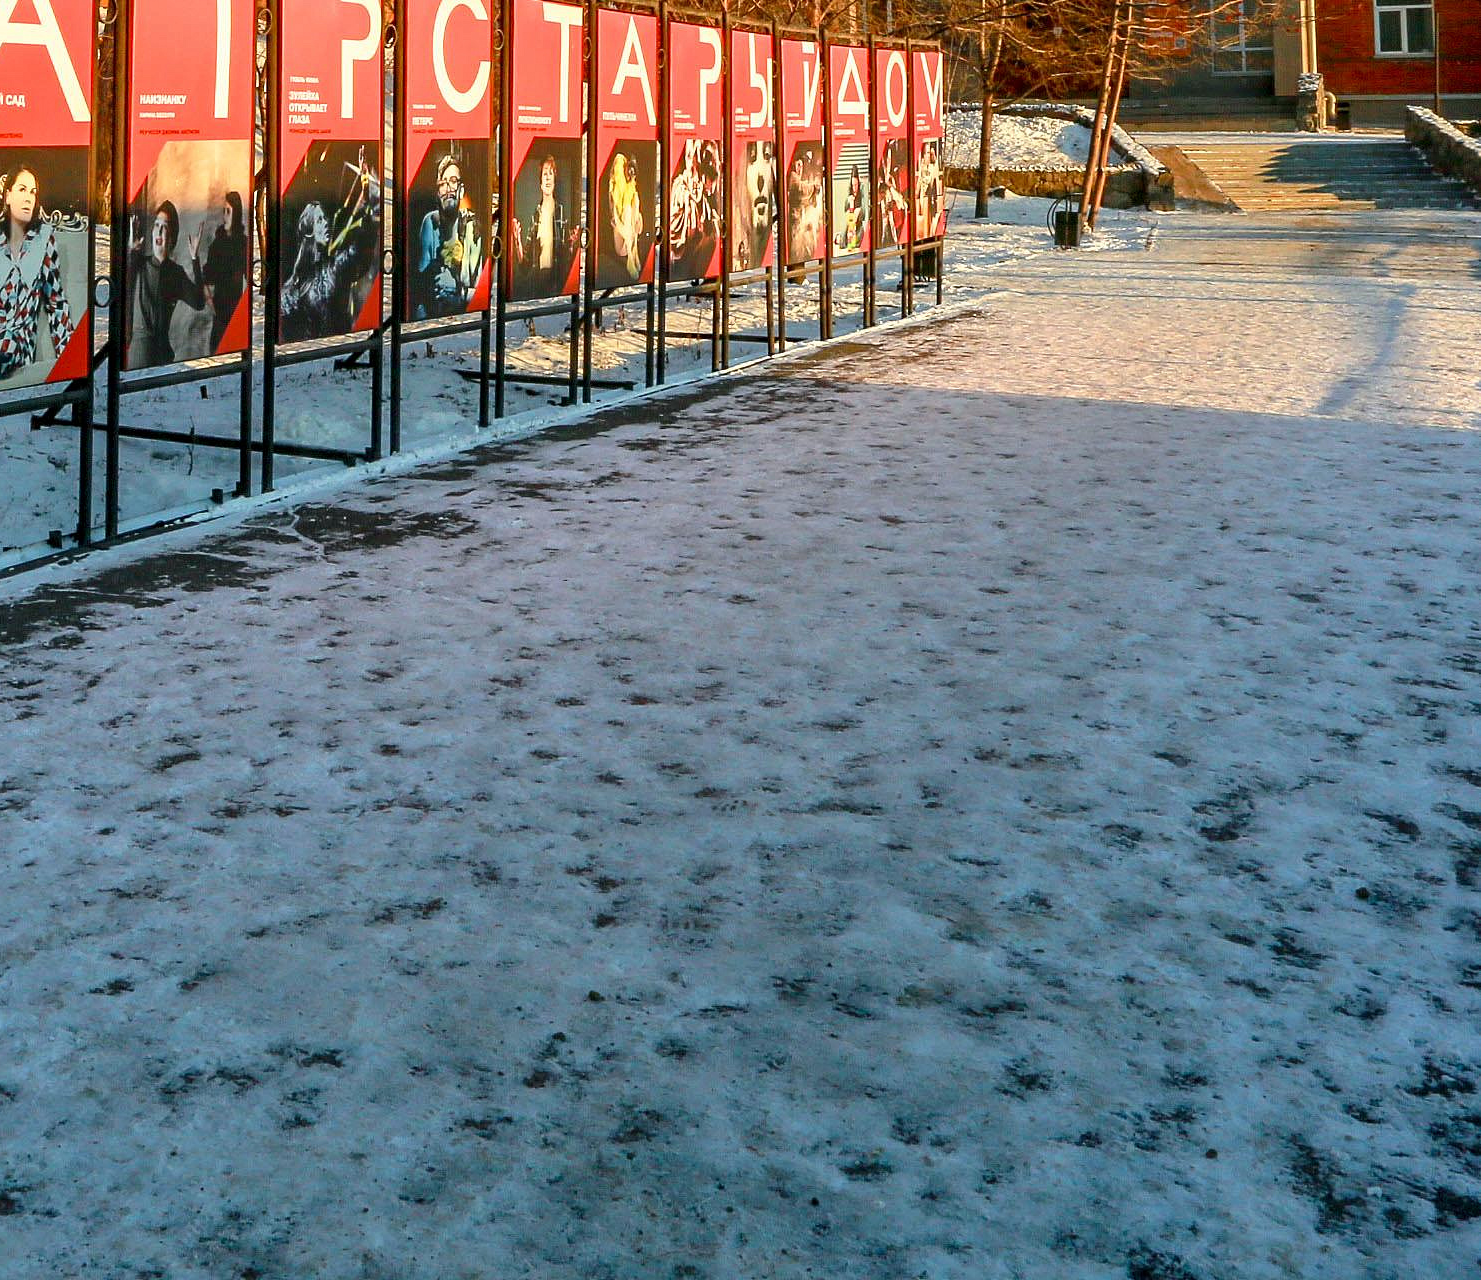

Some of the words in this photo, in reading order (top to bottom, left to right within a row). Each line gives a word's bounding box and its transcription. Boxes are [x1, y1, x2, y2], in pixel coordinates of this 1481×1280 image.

[5, 94, 26, 108] САД
[139, 94, 187, 105] НАИЗНАНКУ
[542, 2, 584, 122] Т
[611, 16, 657, 126] А
[699, 27, 722, 125] Р
[837, 48, 870, 130] Д
[885, 51, 908, 128] О
[288, 114, 311, 124] ГЛАЗА
